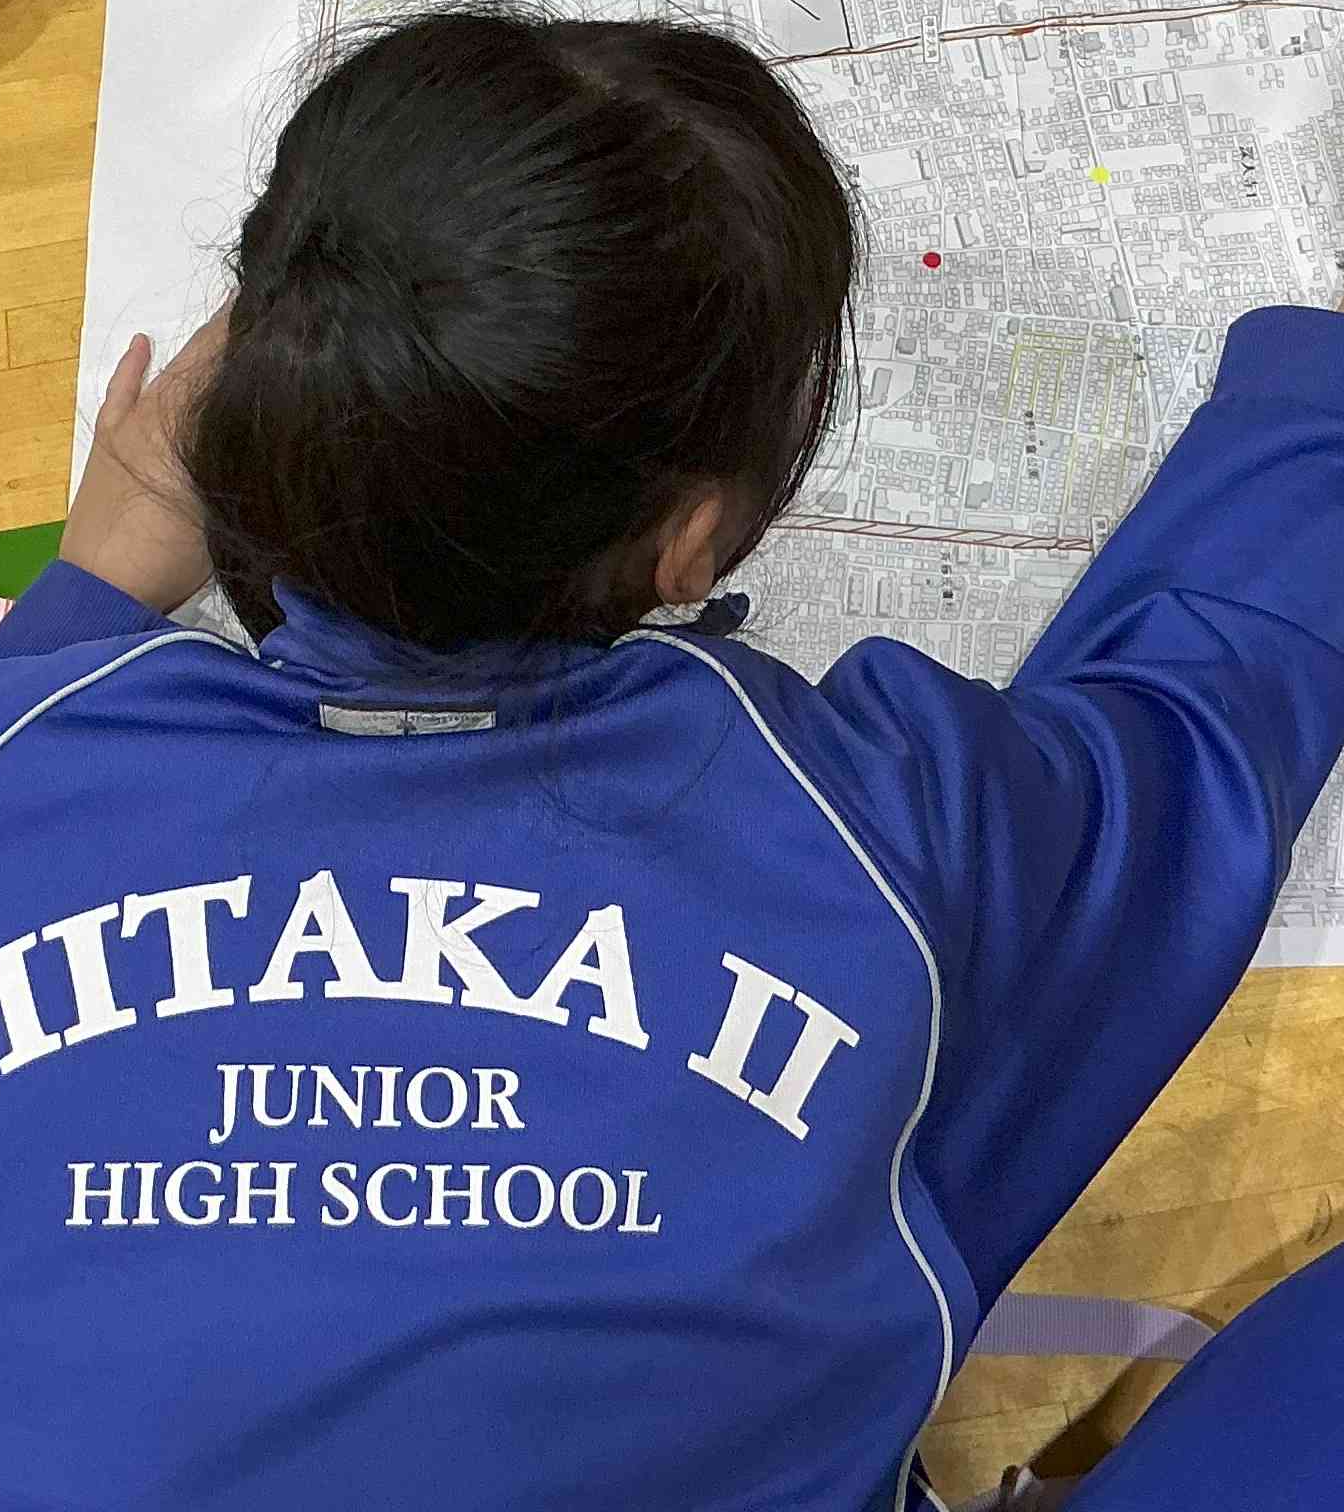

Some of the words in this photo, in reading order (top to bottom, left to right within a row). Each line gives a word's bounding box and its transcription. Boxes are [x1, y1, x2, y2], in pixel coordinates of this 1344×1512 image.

[688, 951, 860, 1141] II
[209, 1063, 526, 1145] JUNIOR
[65, 1160, 298, 1226] HIGH
[321, 1162, 662, 1233] SCHOOL
